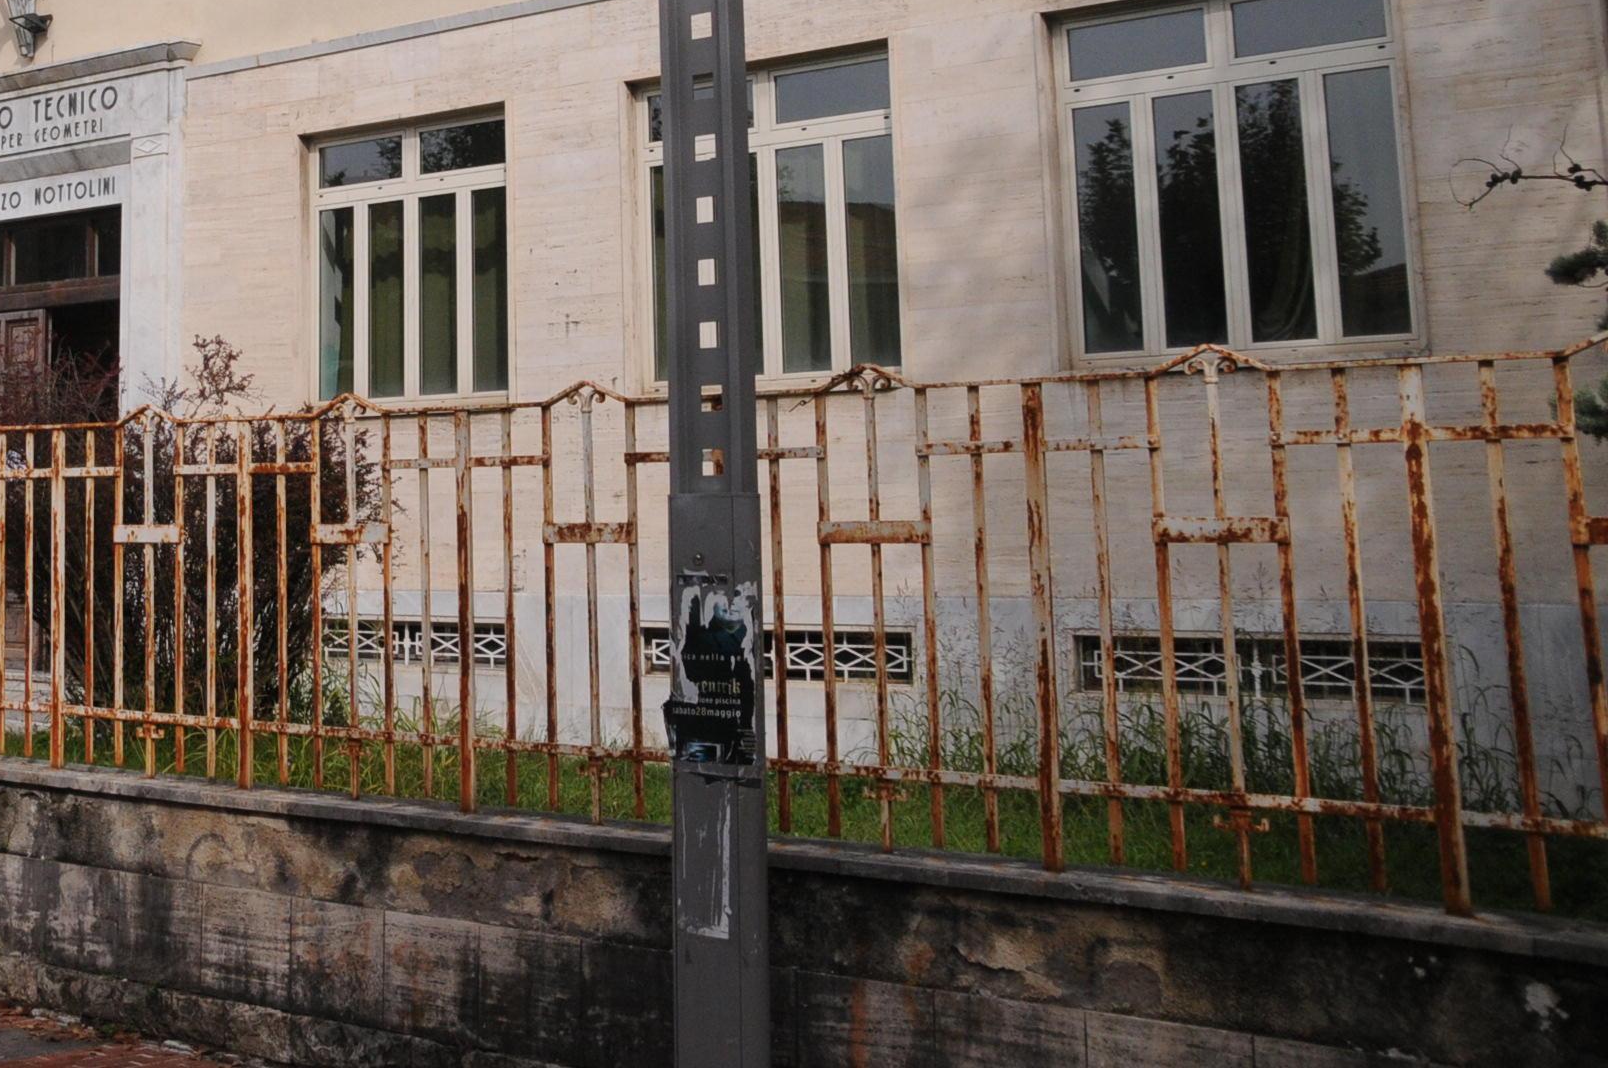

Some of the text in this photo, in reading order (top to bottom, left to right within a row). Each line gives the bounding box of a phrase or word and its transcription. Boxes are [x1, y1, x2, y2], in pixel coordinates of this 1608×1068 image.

[33, 85, 118, 123] TECNICO
[1, 132, 23, 150] PER
[34, 117, 103, 144] GEOMETRI
[34, 175, 116, 207] NOTTOLINI
[715, 697, 741, 706] piscina
